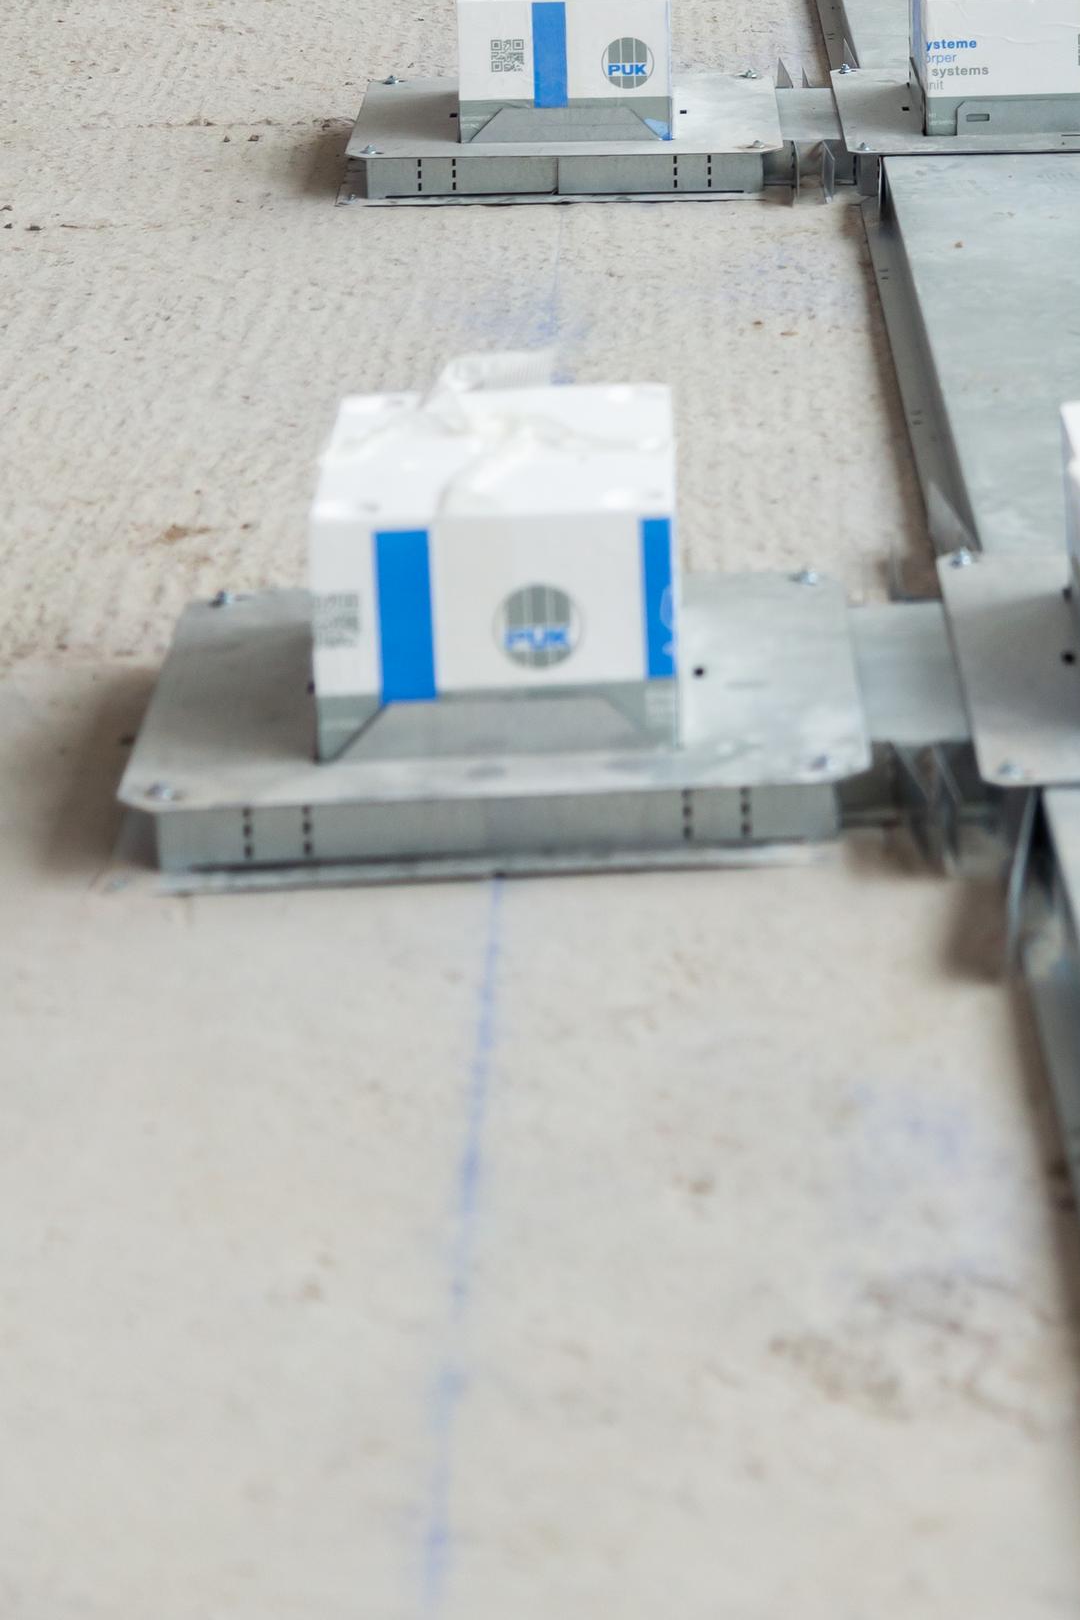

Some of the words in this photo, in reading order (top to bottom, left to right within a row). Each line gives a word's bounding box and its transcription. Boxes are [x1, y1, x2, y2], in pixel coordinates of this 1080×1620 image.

[608, 63, 646, 77] PUK
[932, 66, 990, 78] systems
[505, 627, 568, 653] PUK
